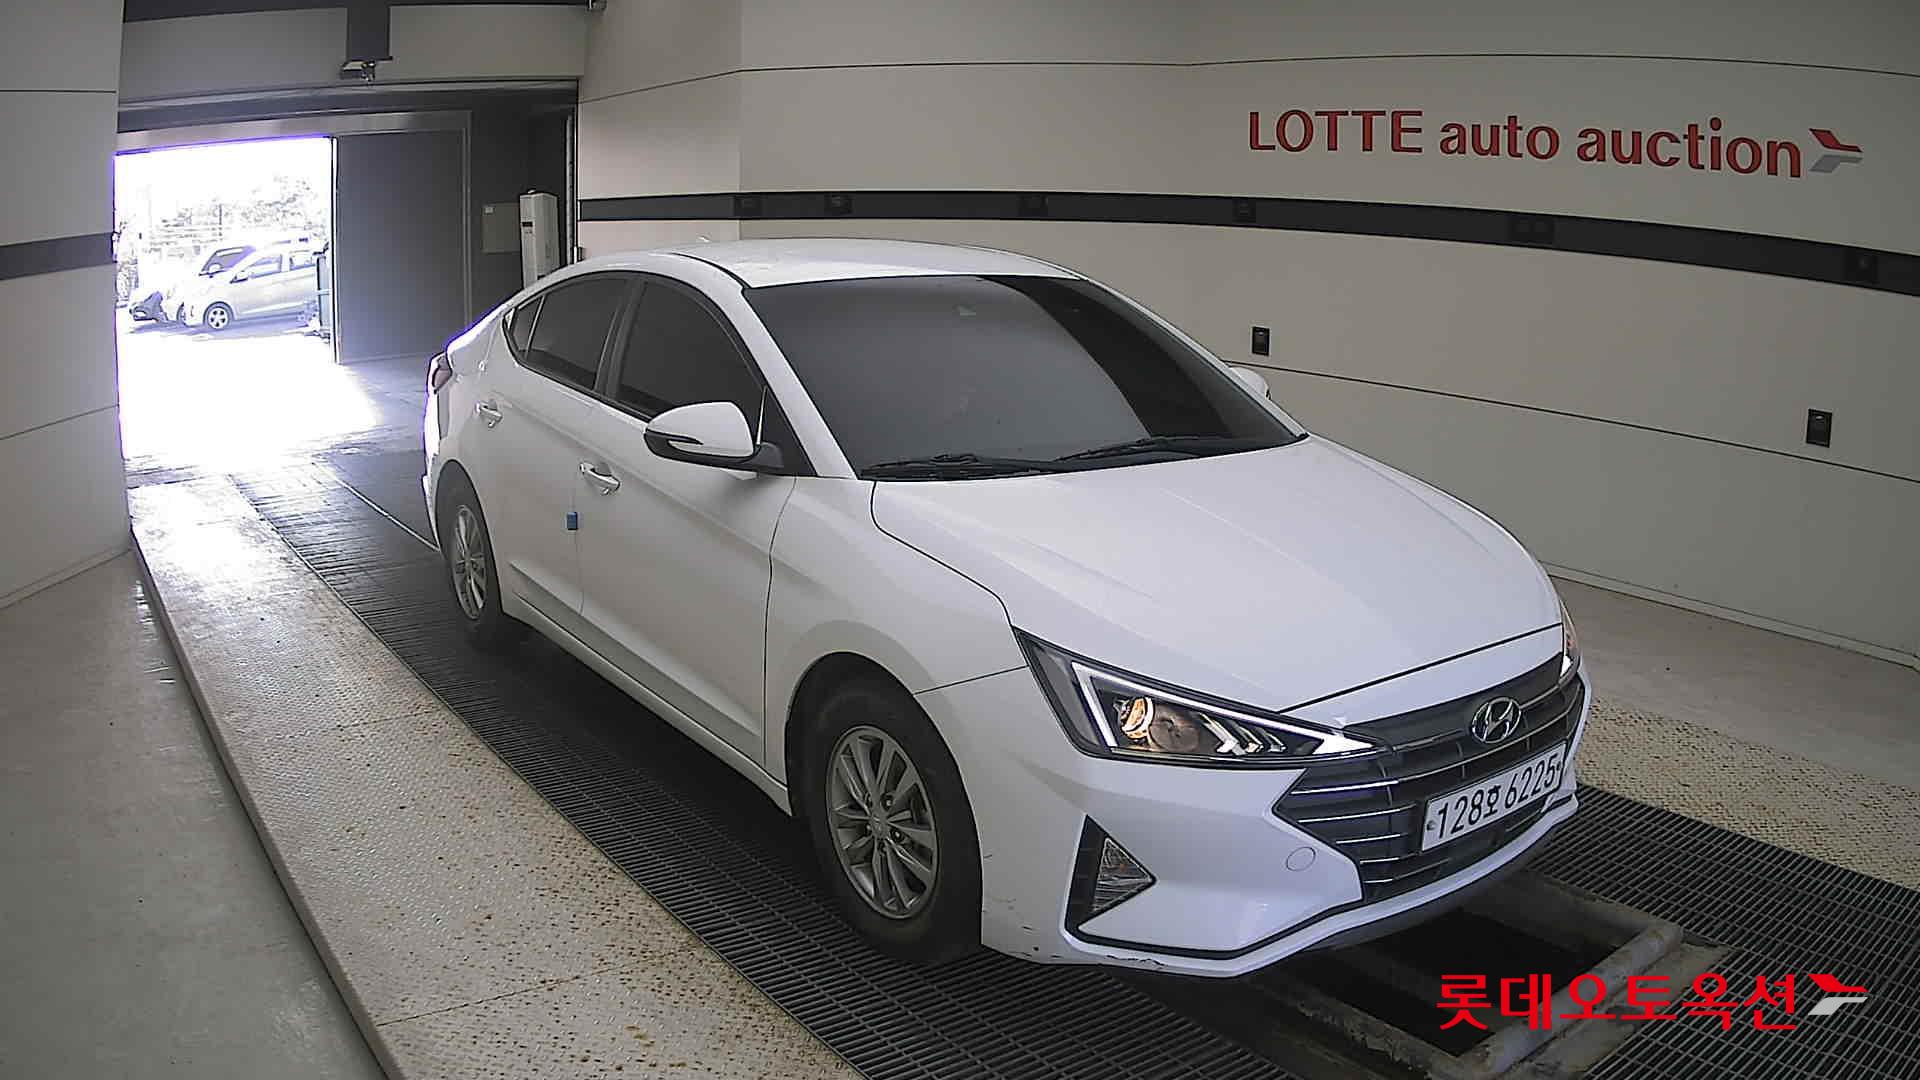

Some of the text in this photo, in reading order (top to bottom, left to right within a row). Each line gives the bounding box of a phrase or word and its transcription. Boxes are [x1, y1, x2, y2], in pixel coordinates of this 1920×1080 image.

[1249, 109, 1801, 178] LOTTE auto auction
[1504, 753, 1559, 809] 6225
